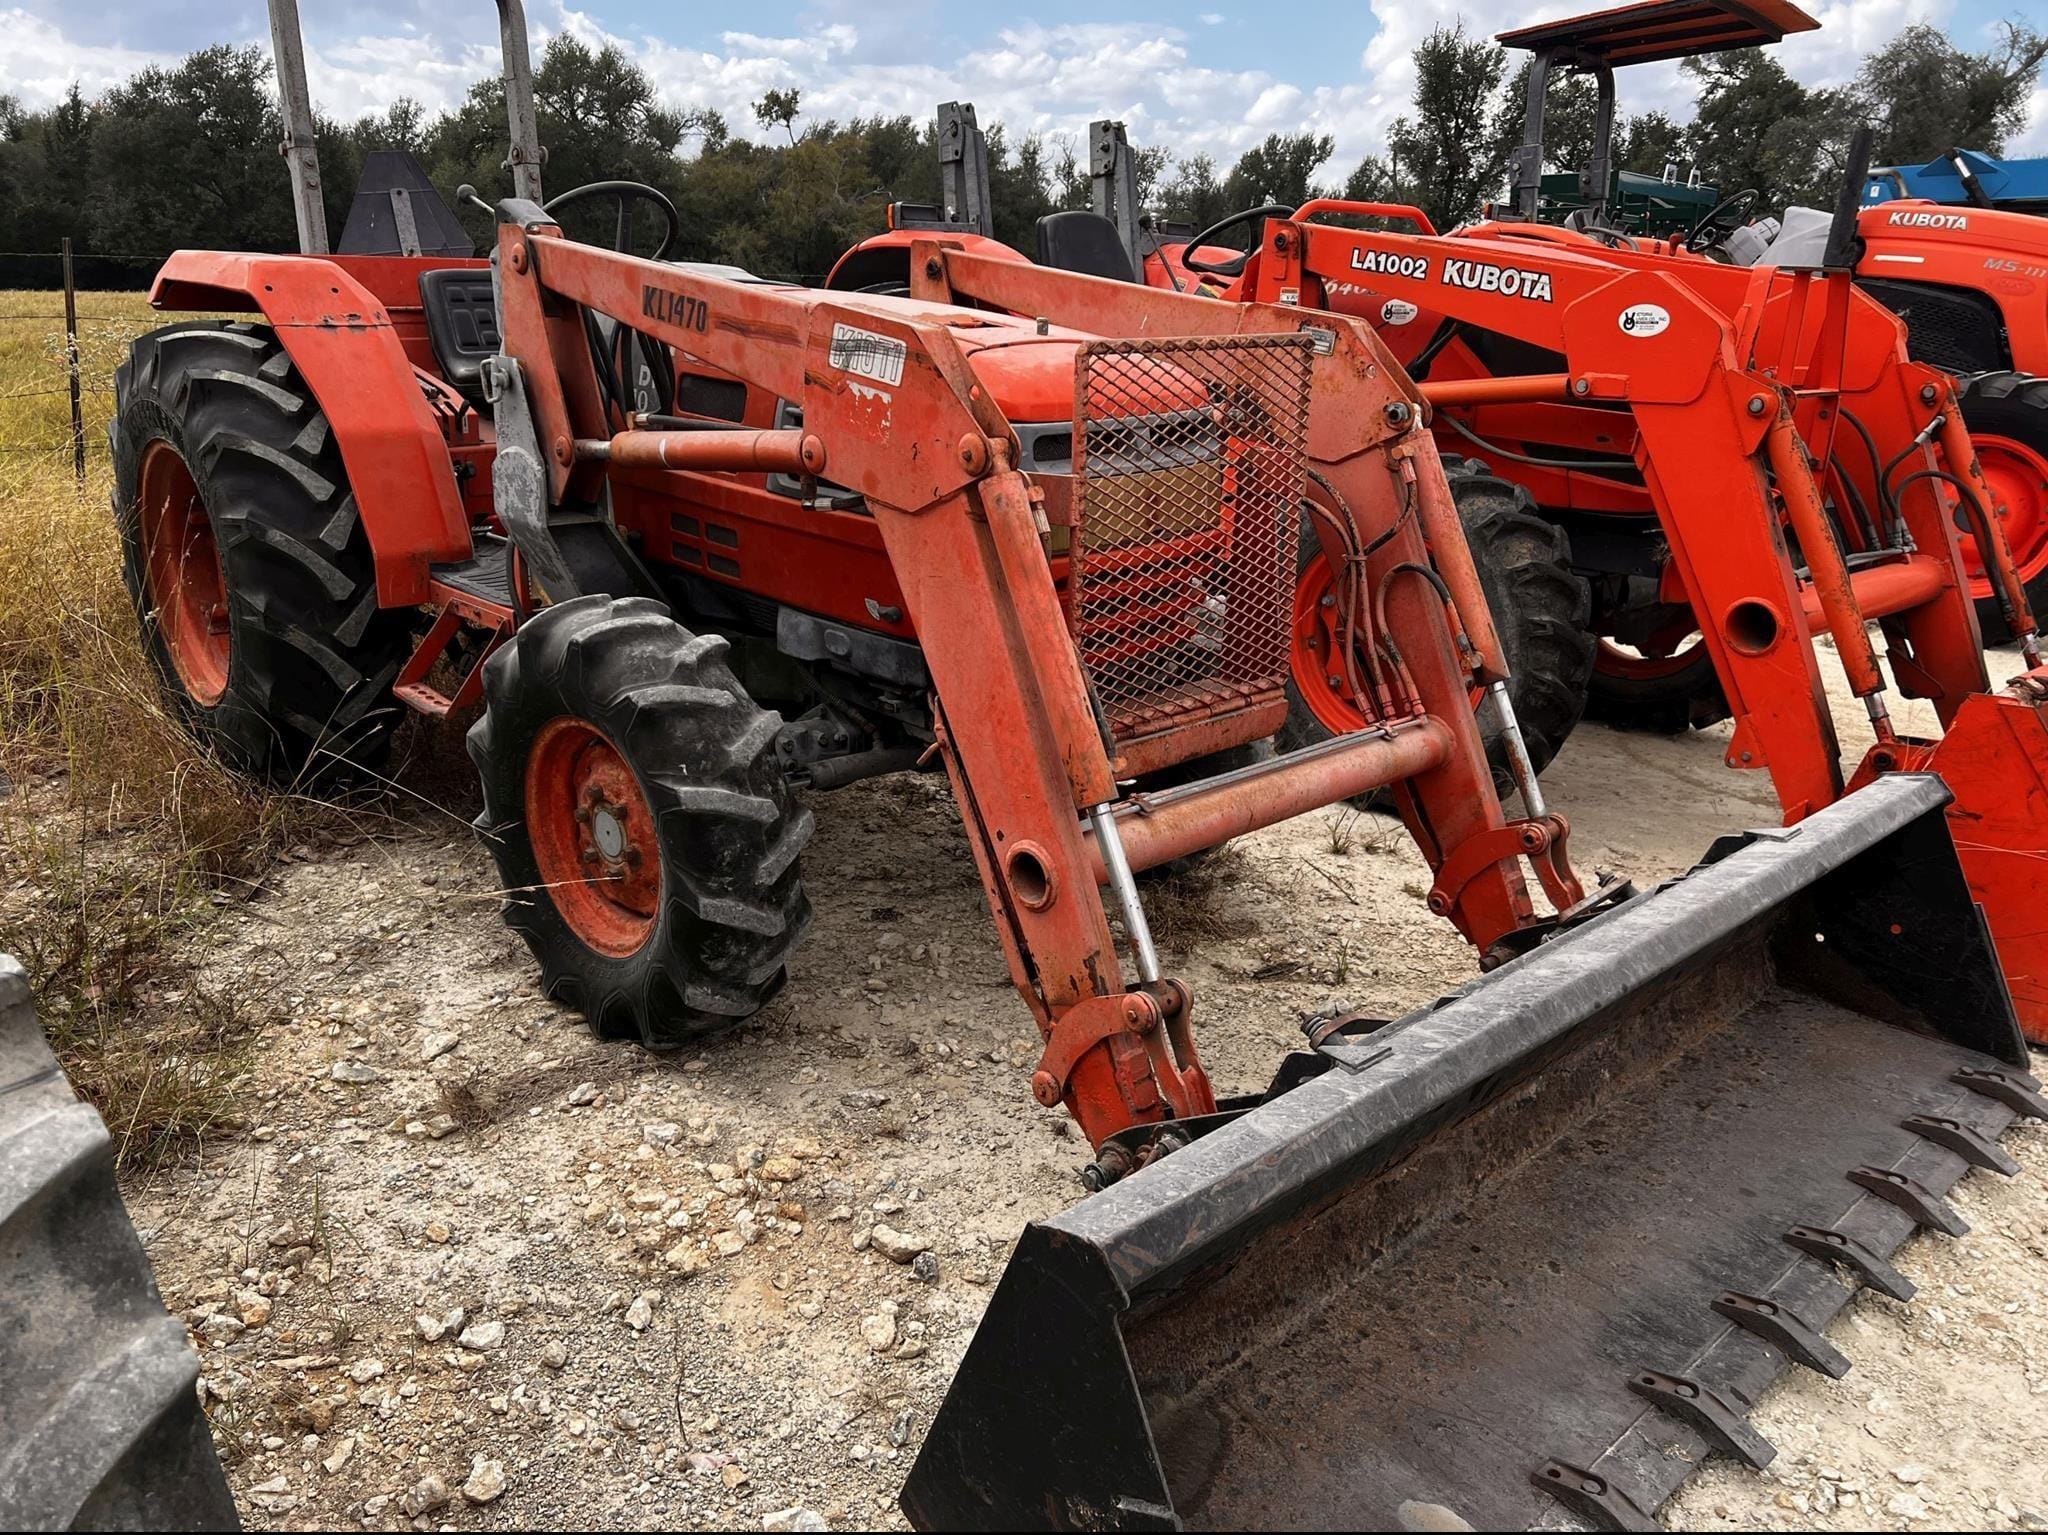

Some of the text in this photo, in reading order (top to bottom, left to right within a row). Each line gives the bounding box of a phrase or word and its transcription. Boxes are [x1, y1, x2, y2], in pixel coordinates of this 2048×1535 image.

[1888, 211, 1968, 230] KUBOTA
[1350, 248, 1554, 303] LA1002 KUBOTA
[642, 285, 708, 332] KL1470
[833, 326, 903, 382] KIOTI
